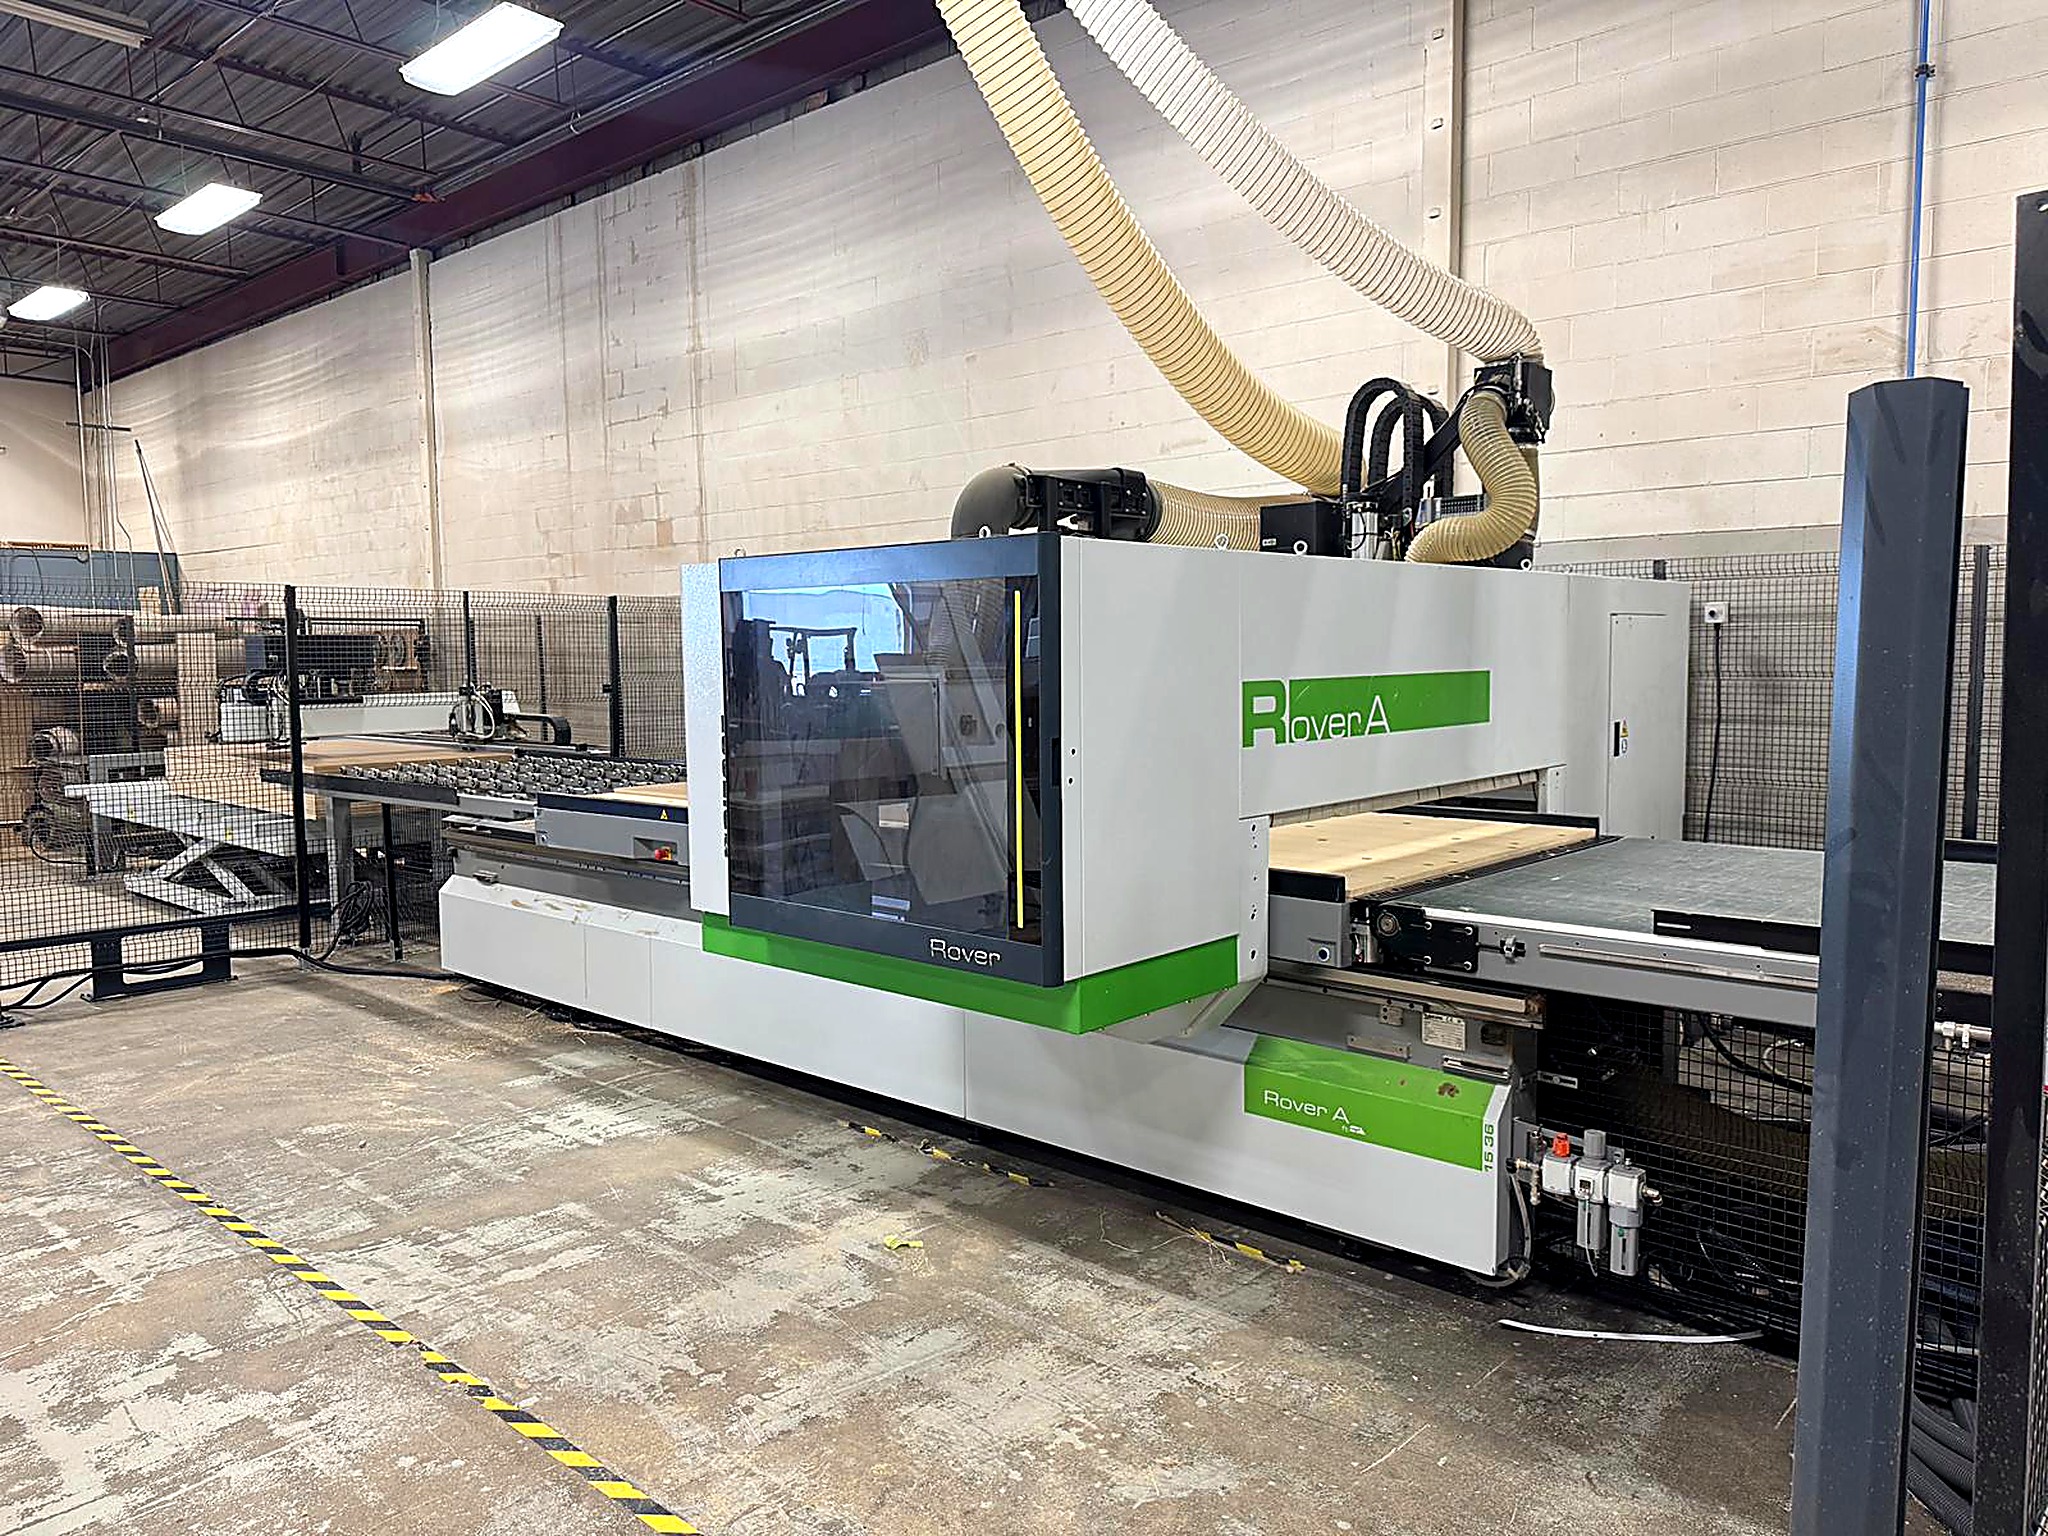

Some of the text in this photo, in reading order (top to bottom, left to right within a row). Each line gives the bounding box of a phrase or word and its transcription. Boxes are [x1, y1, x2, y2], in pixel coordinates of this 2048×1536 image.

[930, 938, 1001, 967] Rover
[1264, 1089, 1350, 1125] Rover A
